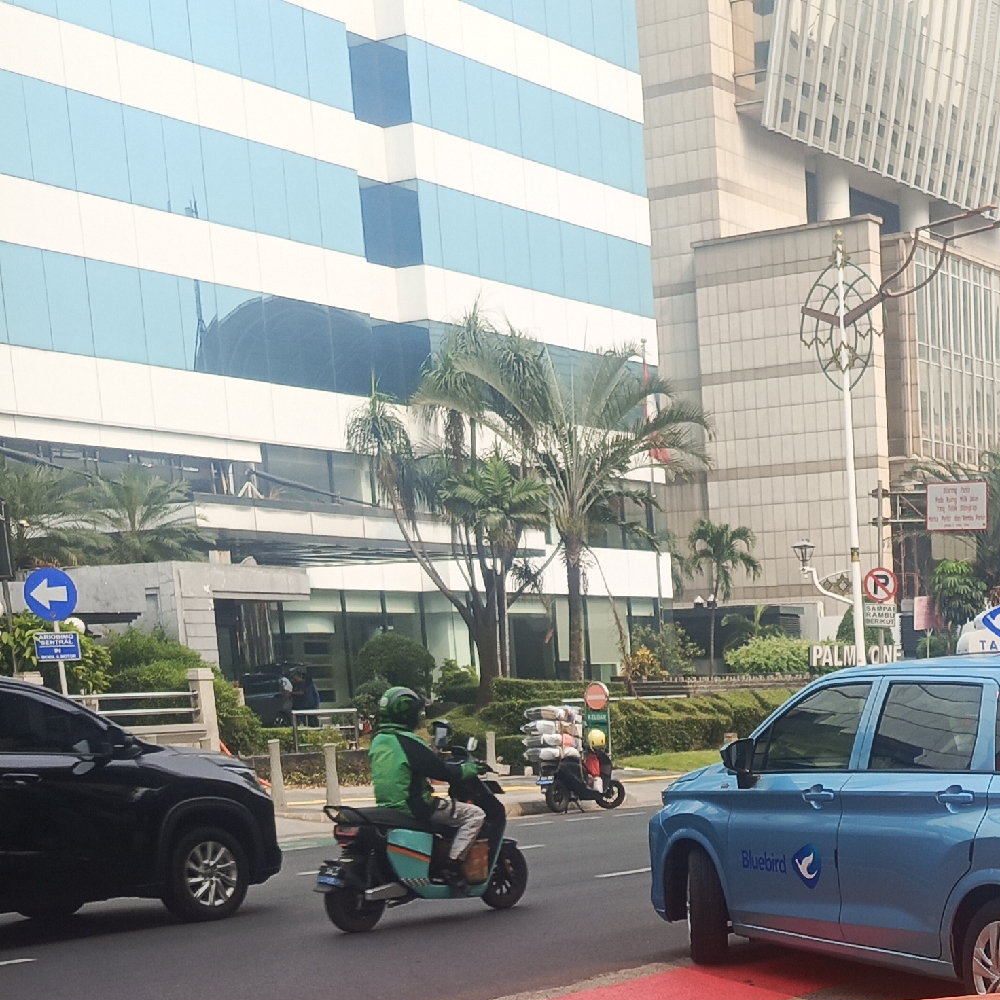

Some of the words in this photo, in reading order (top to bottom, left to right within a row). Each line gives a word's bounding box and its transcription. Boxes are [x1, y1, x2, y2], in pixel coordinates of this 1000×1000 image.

[812, 645, 856, 667] PALM
[870, 645, 902, 665] ONE
[741, 850, 787, 875] Bluebird
